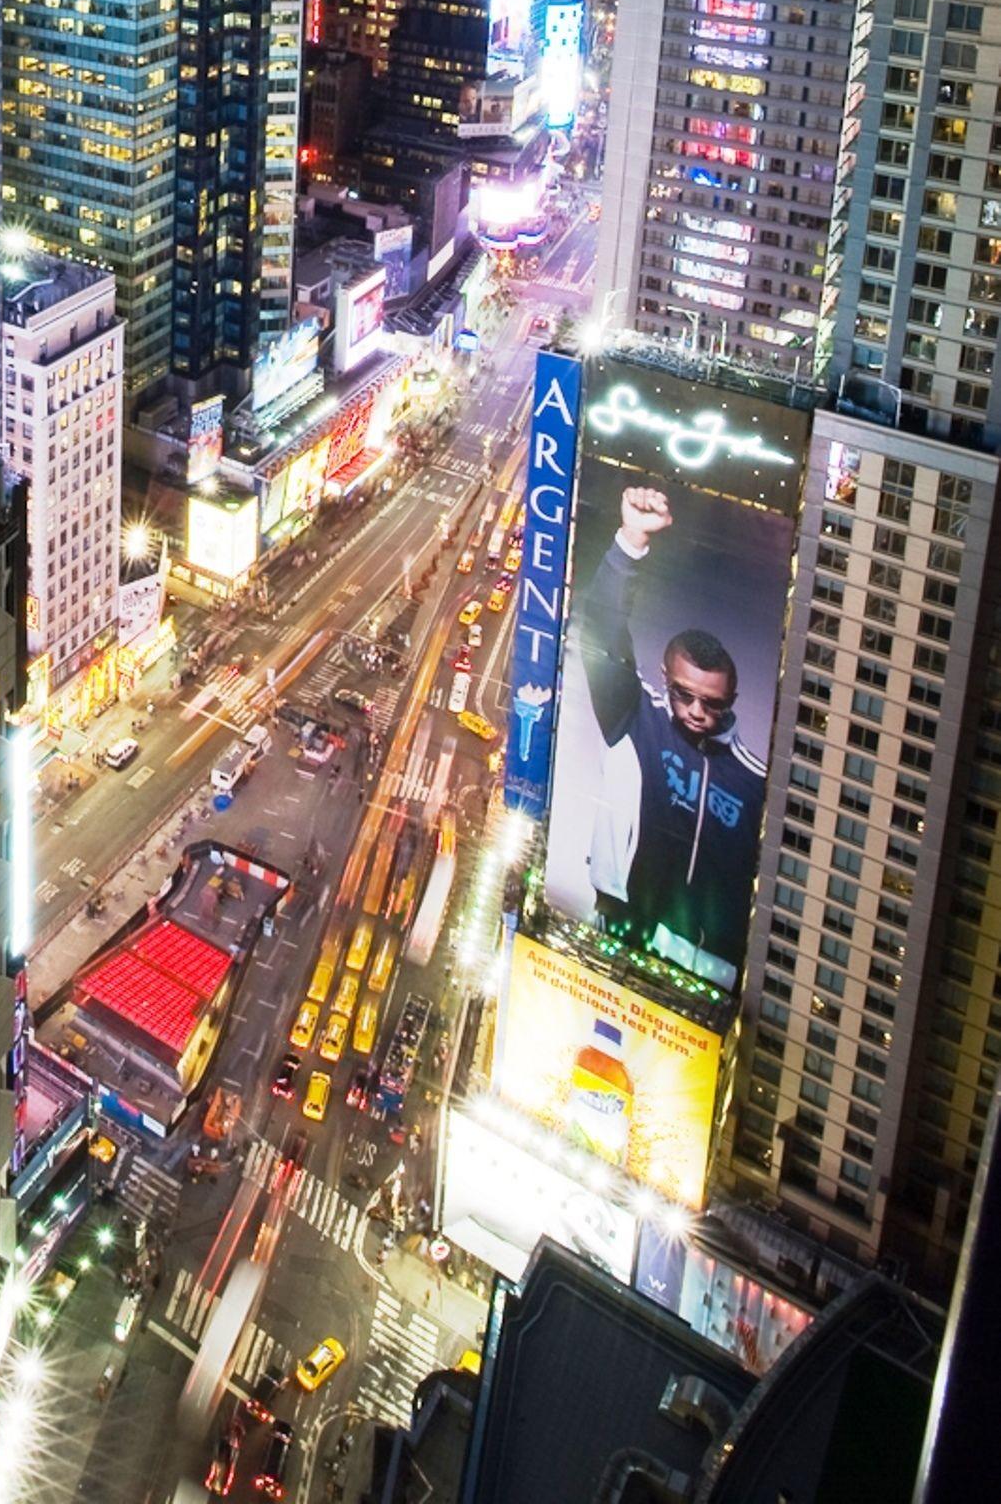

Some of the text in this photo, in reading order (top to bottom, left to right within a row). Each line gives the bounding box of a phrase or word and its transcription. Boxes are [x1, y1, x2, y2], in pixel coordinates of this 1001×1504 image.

[519, 377, 575, 663] ARGENT
[527, 950, 709, 1052] Antioxidants. Disguised
[533, 968, 694, 1059] in delicious tea form.
